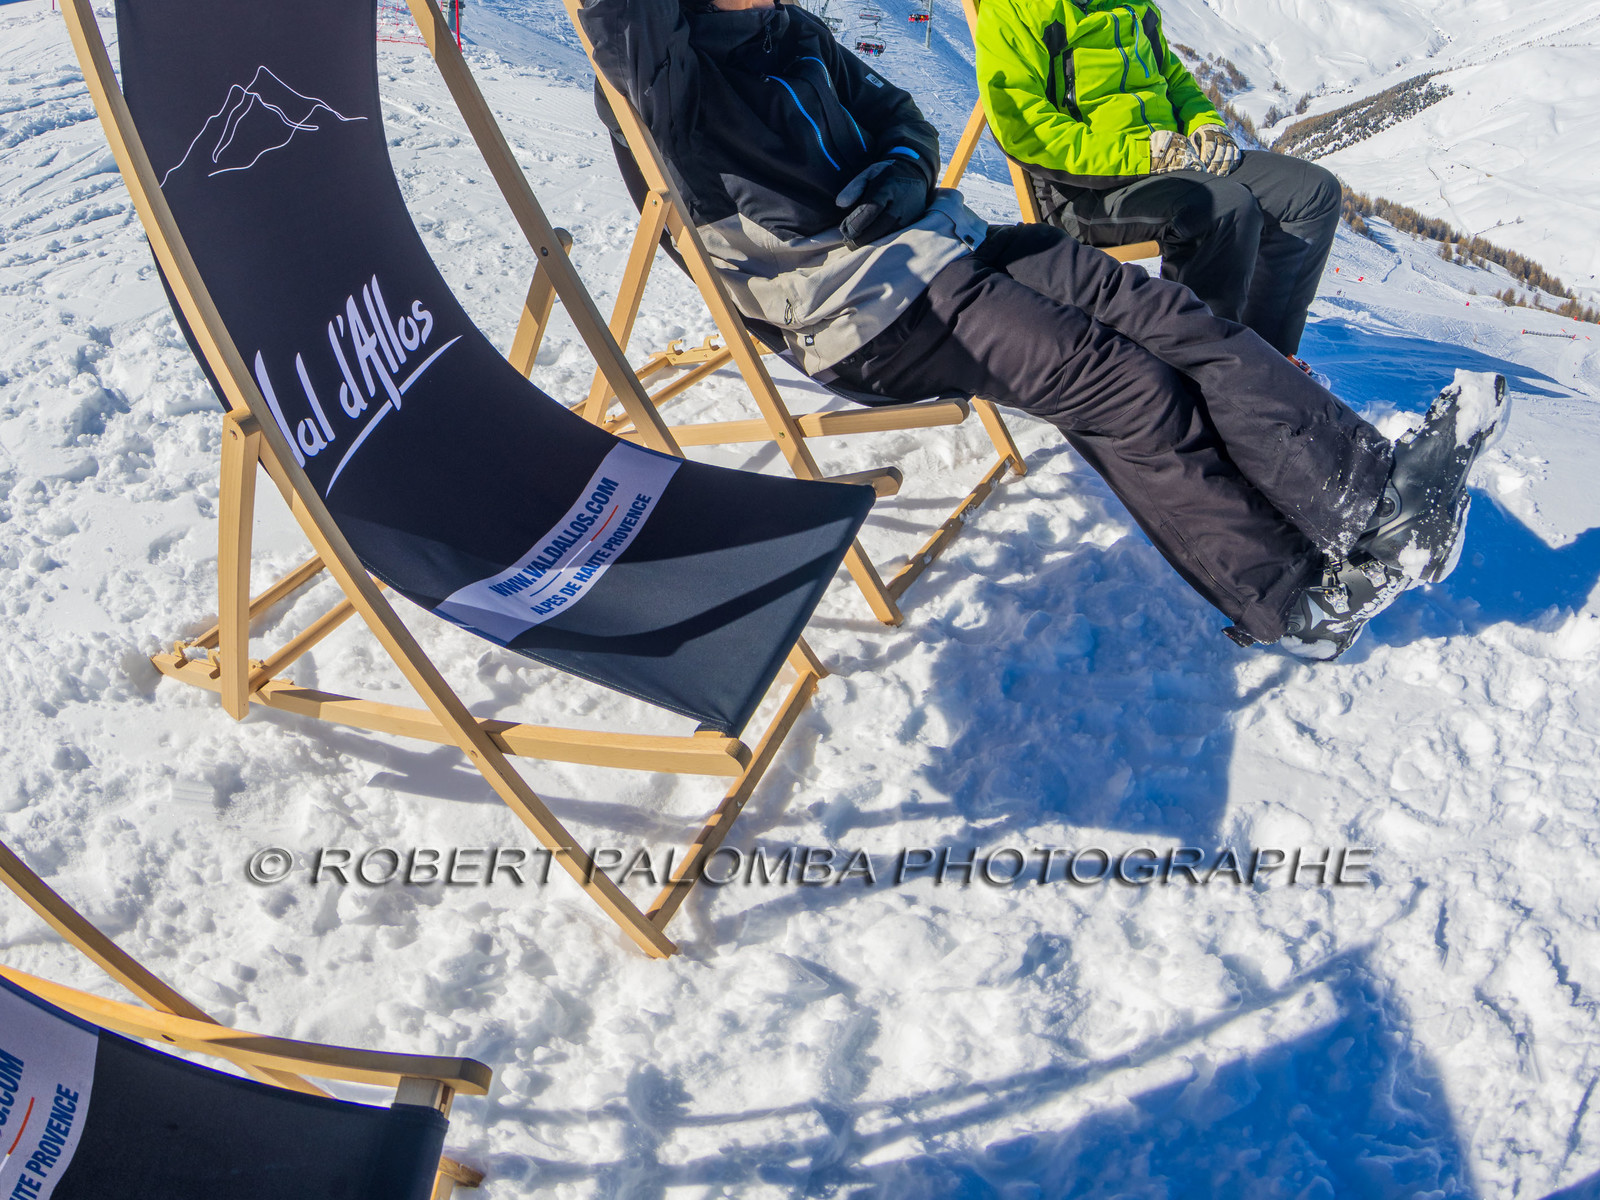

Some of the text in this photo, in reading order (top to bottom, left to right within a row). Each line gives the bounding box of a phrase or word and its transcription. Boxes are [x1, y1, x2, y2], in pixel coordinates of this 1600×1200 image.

[328, 273, 434, 419] d'Allos
[488, 476, 620, 597] WWW.VALDALLOS.COM
[530, 493, 652, 616] ALPES DE HAUTE PROVENCE
[25, 1082, 80, 1179] PROVENCE
